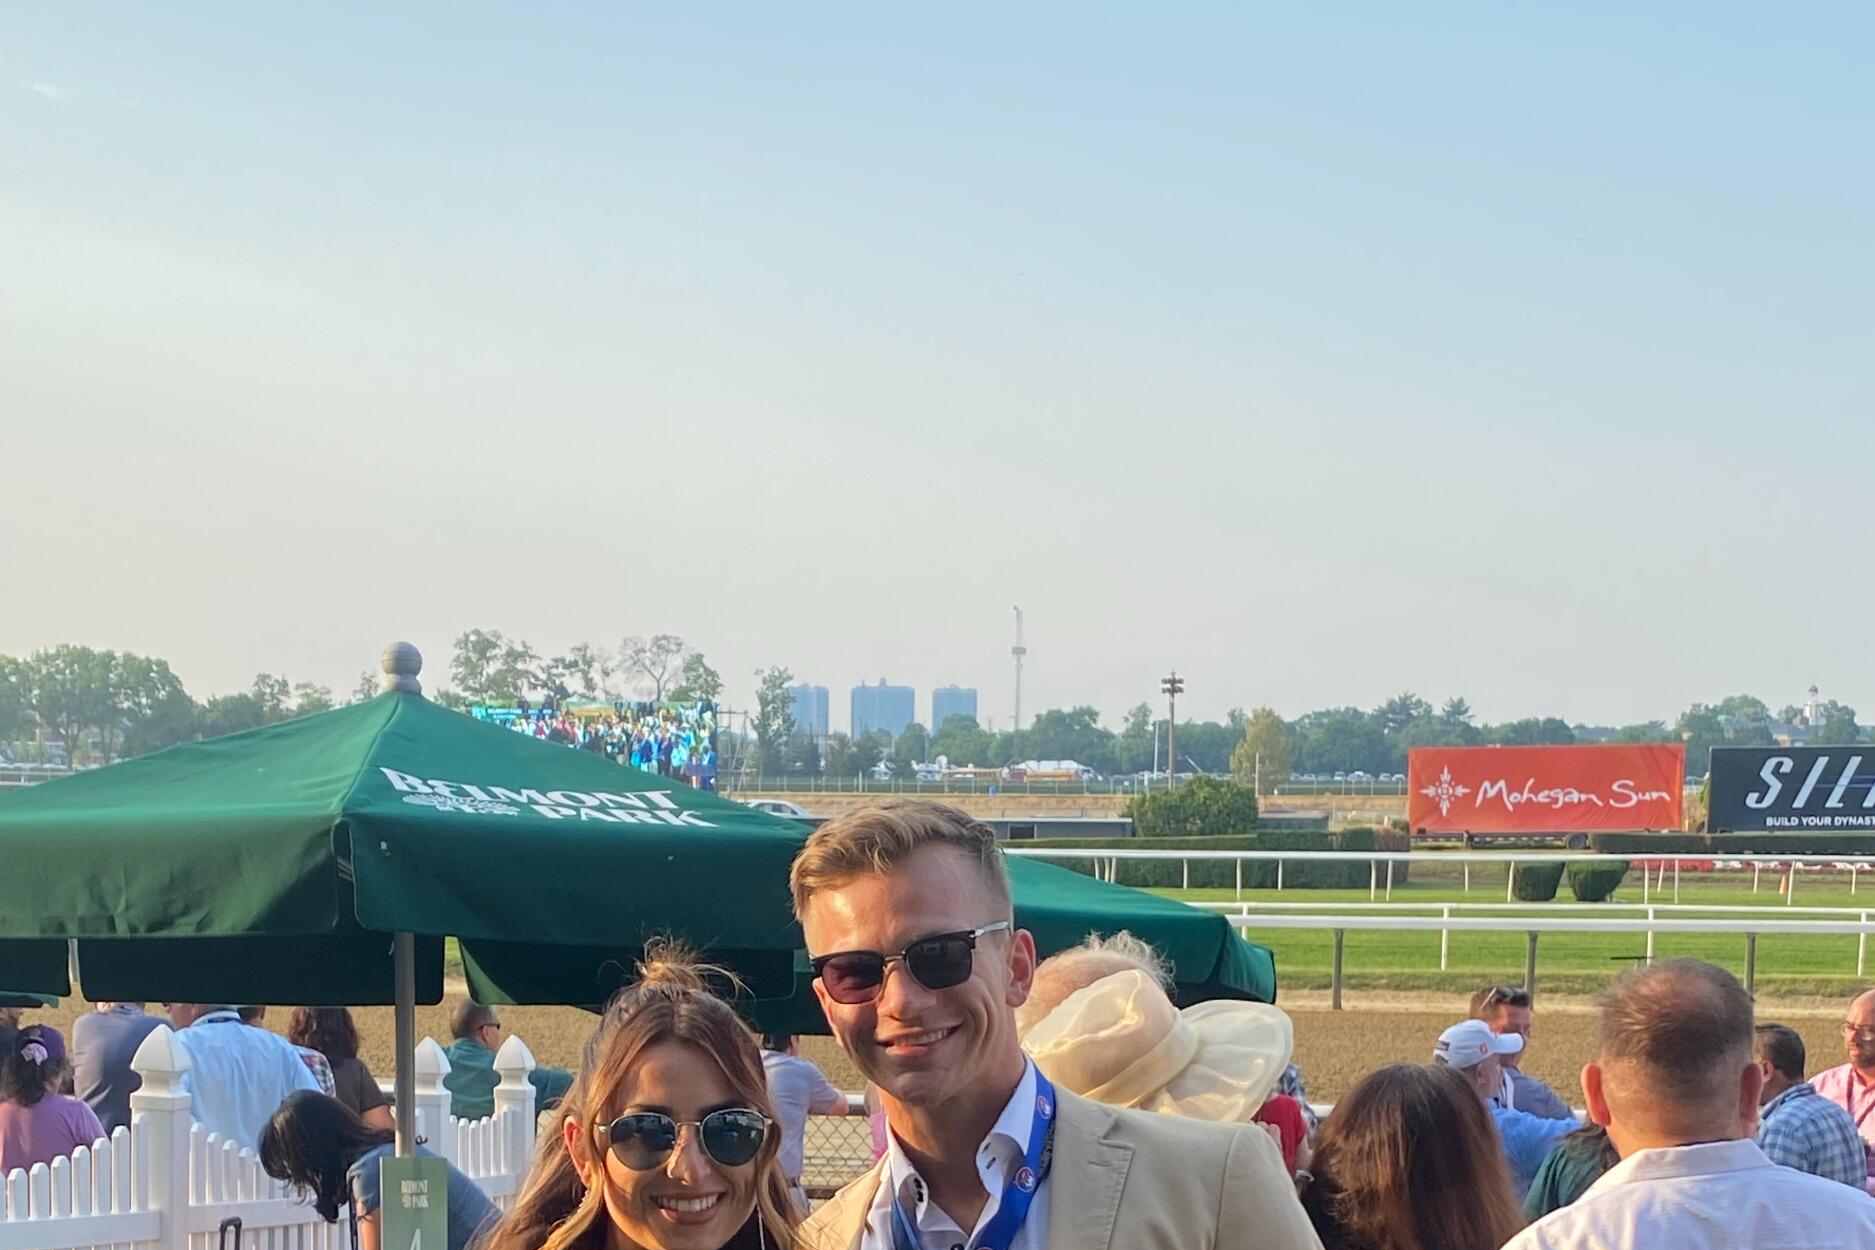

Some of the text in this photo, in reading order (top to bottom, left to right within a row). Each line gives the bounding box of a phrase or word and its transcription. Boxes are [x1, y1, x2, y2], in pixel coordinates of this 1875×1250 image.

[380, 767, 679, 809] BELMONT
[1475, 778, 1671, 812] Mohegan Sun
[529, 804, 720, 828] PARK
[1766, 815, 1799, 827] BUILD
[1801, 815, 1832, 827] YOUR
